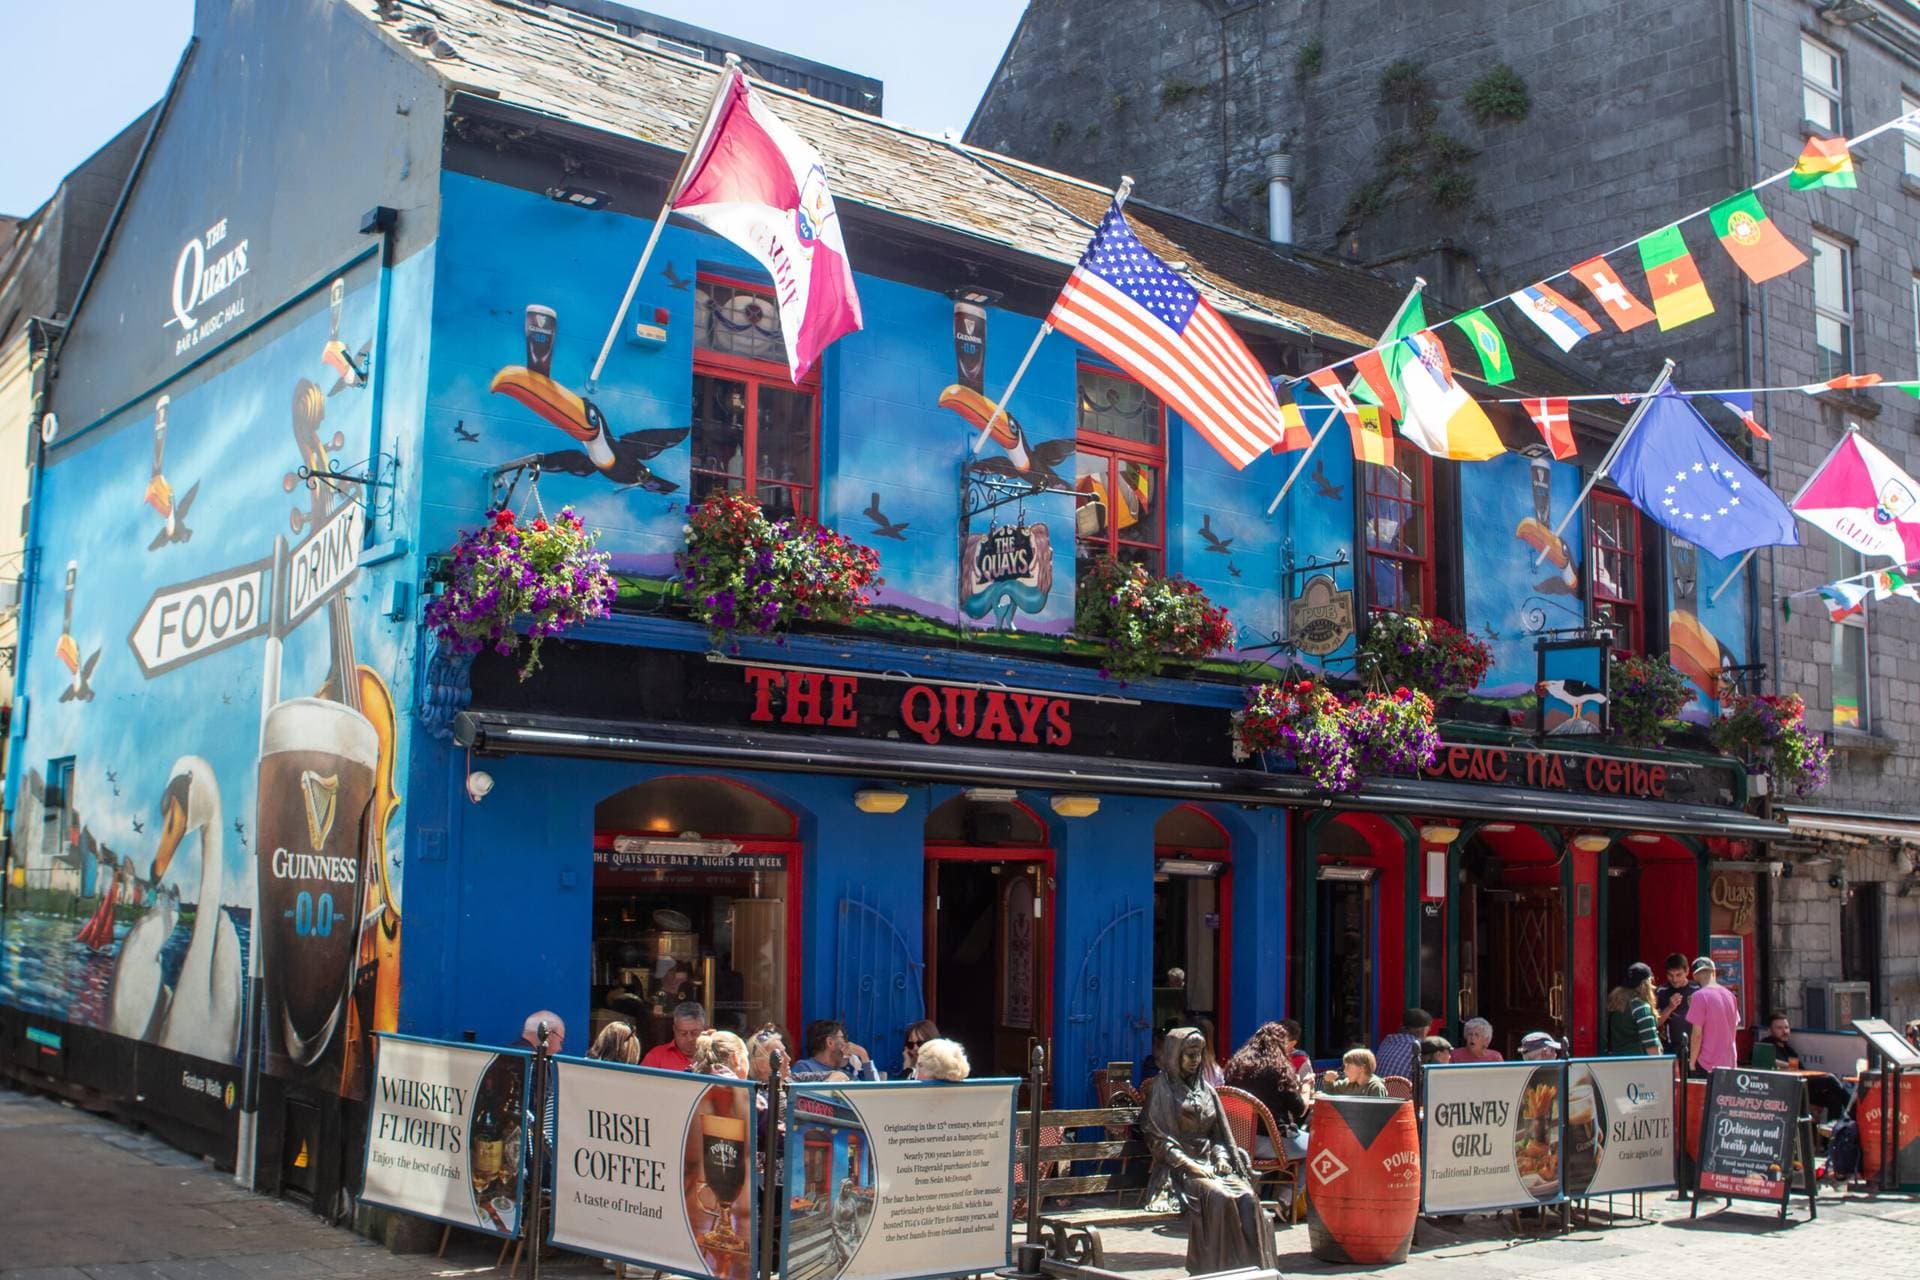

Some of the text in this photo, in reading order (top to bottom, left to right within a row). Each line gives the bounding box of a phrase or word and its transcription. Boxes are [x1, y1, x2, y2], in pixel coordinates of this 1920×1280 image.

[206, 217, 227, 250] THE
[163, 238, 250, 329] Quays
[176, 297, 245, 356] BAR & MUSIC HALL
[994, 537, 1015, 554] THE
[294, 506, 354, 614] DRINK
[982, 549, 1028, 582] QUAYS
[157, 580, 255, 658] FOOD
[1303, 605, 1337, 626] PUB
[745, 667, 1072, 746] THE QUAYS
[272, 847, 357, 884] GUINNESS
[593, 853, 782, 867] THE QUAYS LATE BAR 7 NIGHTS PER WEEK
[1712, 877, 1755, 909] Quays
[296, 889, 334, 938] 0.0
[182, 1070, 222, 1099] Feature Walls
[1736, 1074, 1769, 1091] Quays
[381, 1076, 468, 1116] WHISKEY
[1627, 1083, 1656, 1104] Quays
[1716, 1095, 1788, 1113] GALWAY GIRL
[1435, 1100, 1509, 1128] GALWAY
[378, 1112, 462, 1154] FLIGHTS
[588, 1109, 651, 1147] IRISH
[884, 1123, 918, 1133] Originating
[919, 1123, 925, 1131] in
[926, 1122, 936, 1131] the
[973, 1120, 986, 1128] when
[1613, 1117, 1670, 1143] SLÁINTE
[1718, 1118, 1780, 1139] Delicious and
[888, 1137, 898, 1146] the
[899, 1136, 925, 1146] premises
[926, 1134, 945, 1143] served
[1452, 1133, 1492, 1158] GIRL
[1720, 1137, 1748, 1157] hearty
[904, 1152, 923, 1161] Nearly
[925, 1151, 936, 1160] 700
[936, 1151, 952, 1160] years
[952, 1149, 966, 1158] later
[966, 1149, 972, 1157] in
[1618, 1149, 1635, 1161] Craic
[1722, 1159, 1736, 1167] Food
[1737, 1160, 1754, 1169] served
[372, 1151, 460, 1181] Enjoy the best of Irish
[574, 1147, 666, 1193] COFFEE
[896, 1165, 913, 1174] Louis
[914, 1163, 943, 1173] Fitzgerald
[943, 1161, 971, 1172] purchased
[1321, 1160, 1332, 1174] P
[1431, 1164, 1511, 1180] Traditional Restaurant
[914, 1177, 929, 1186] from
[574, 1191, 663, 1220] A taste of Ireland
[882, 1196, 892, 1204] The
[893, 1195, 904, 1203] bar
[905, 1194, 915, 1202] has
[916, 1193, 938, 1202] become
[890, 1206, 925, 1217] particularly
[926, 1205, 935, 1213] the
[965, 1200, 982, 1209] which
[983, 1199, 993, 1207] has
[883, 1221, 903, 1230] hosted
[954, 1214, 970, 1223] many
[988, 1210, 999, 1219] and
[885, 1234, 896, 1242] the
[896, 1232, 909, 1241] best
